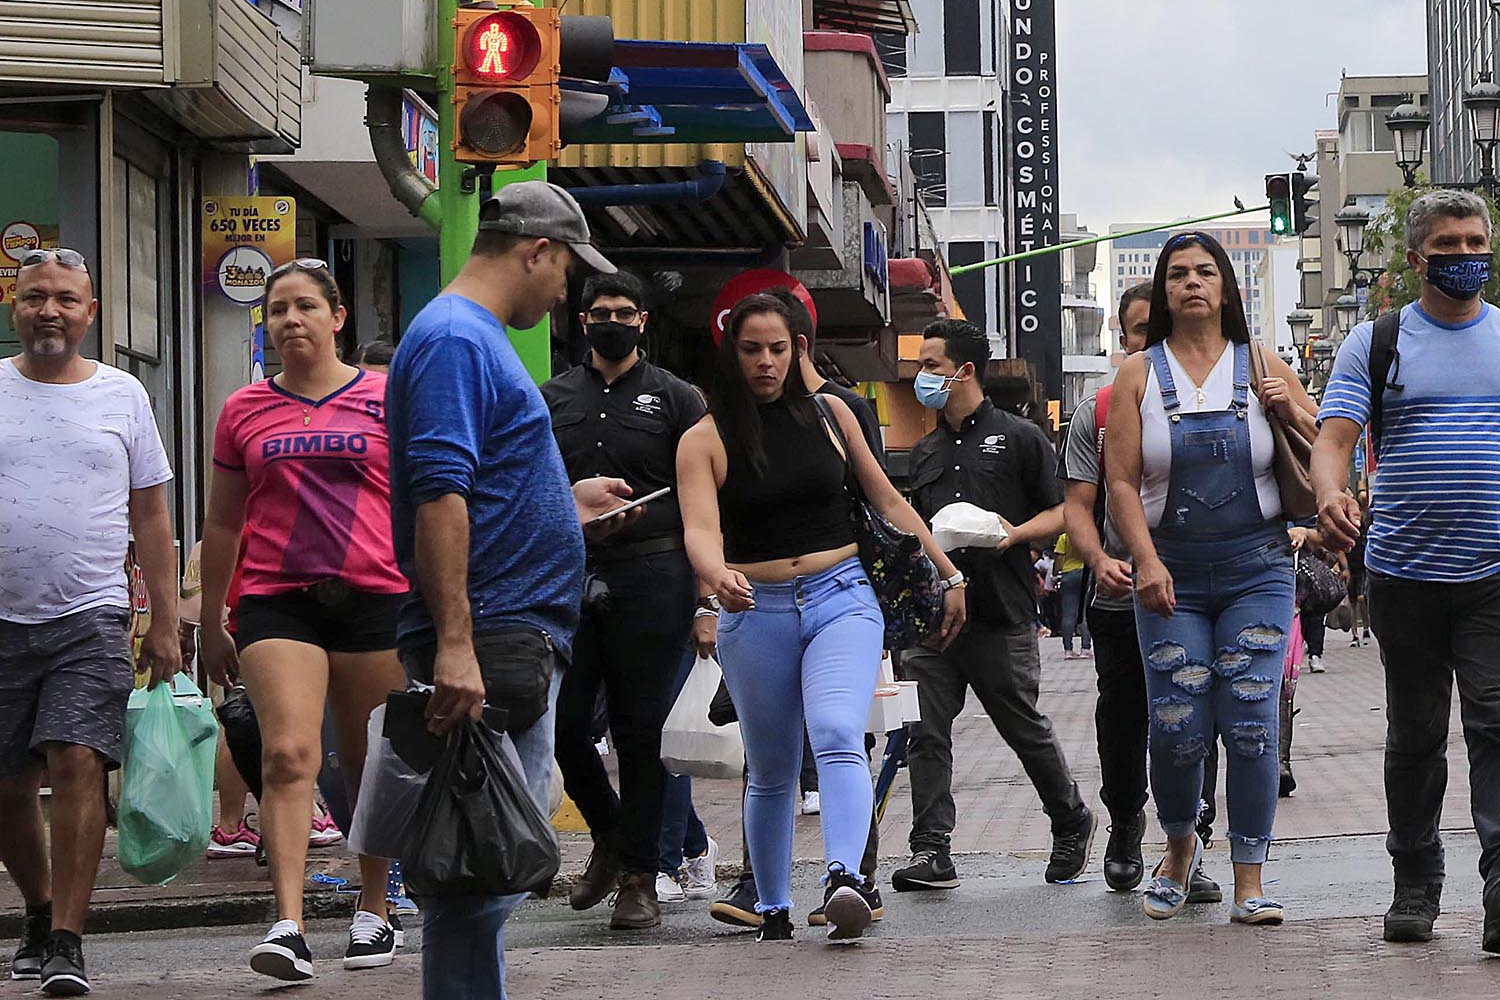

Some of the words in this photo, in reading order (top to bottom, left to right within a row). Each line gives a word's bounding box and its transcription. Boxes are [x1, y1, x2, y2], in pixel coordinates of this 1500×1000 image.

[1040, 52, 1053, 246] PROFESSIONAL
[230, 208, 240, 217] TU
[243, 205, 258, 217] DÍA
[210, 219, 237, 232] 650
[242, 219, 280, 231] VECES
[1016, 116, 1039, 333] COSMÉTICO
[255, 234, 265, 242] EN
[227, 265, 238, 279] 3
[262, 433, 367, 459] BIMBO
